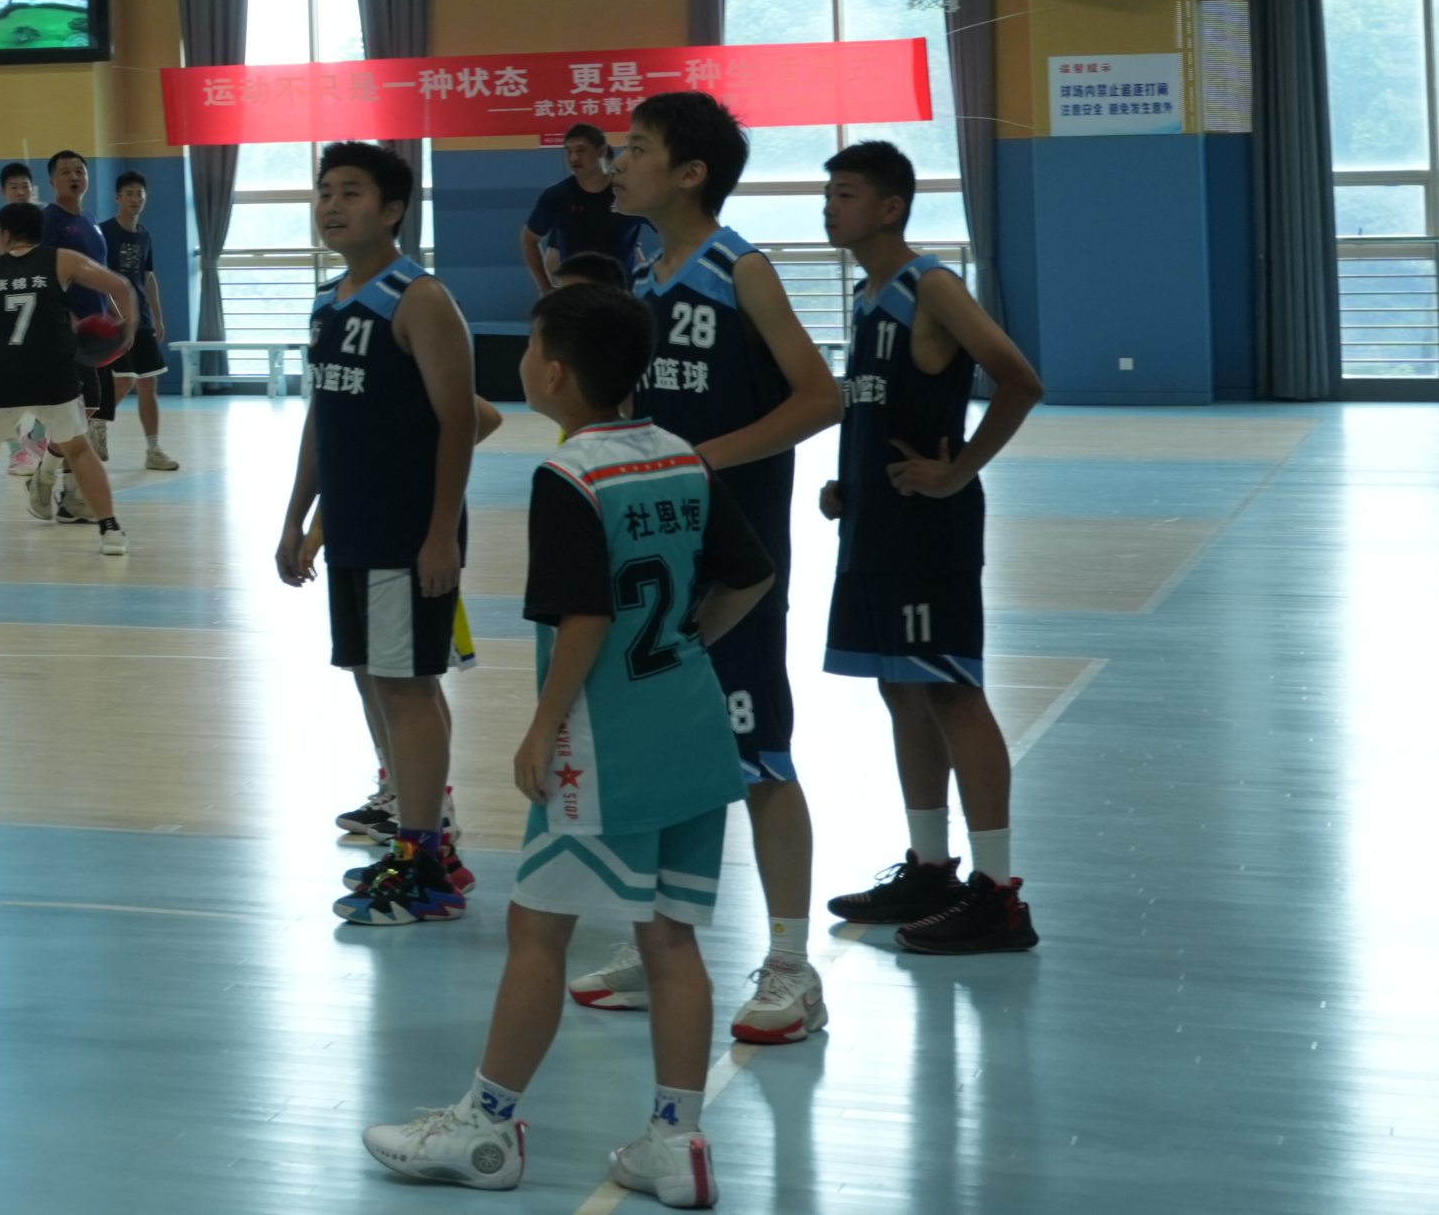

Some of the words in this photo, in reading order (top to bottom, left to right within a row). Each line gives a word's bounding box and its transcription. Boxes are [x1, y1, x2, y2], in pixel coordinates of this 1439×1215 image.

[202, 66, 529, 106] 运动不只是一种状态
[1059, 62, 1112, 74] 温馨提示
[1060, 83, 1169, 99] 球场内禁止追逐打闹
[1060, 103, 1104, 117] 注意安全
[1108, 102, 1173, 116] 避免发生意外
[4, 292, 37, 346] 7
[341, 316, 374, 356] 21
[668, 301, 717, 349] 28
[876, 320, 898, 361] 11
[902, 602, 931, 643] 11
[563, 792, 579, 820] STOP
[481, 1090, 516, 1120] 24
